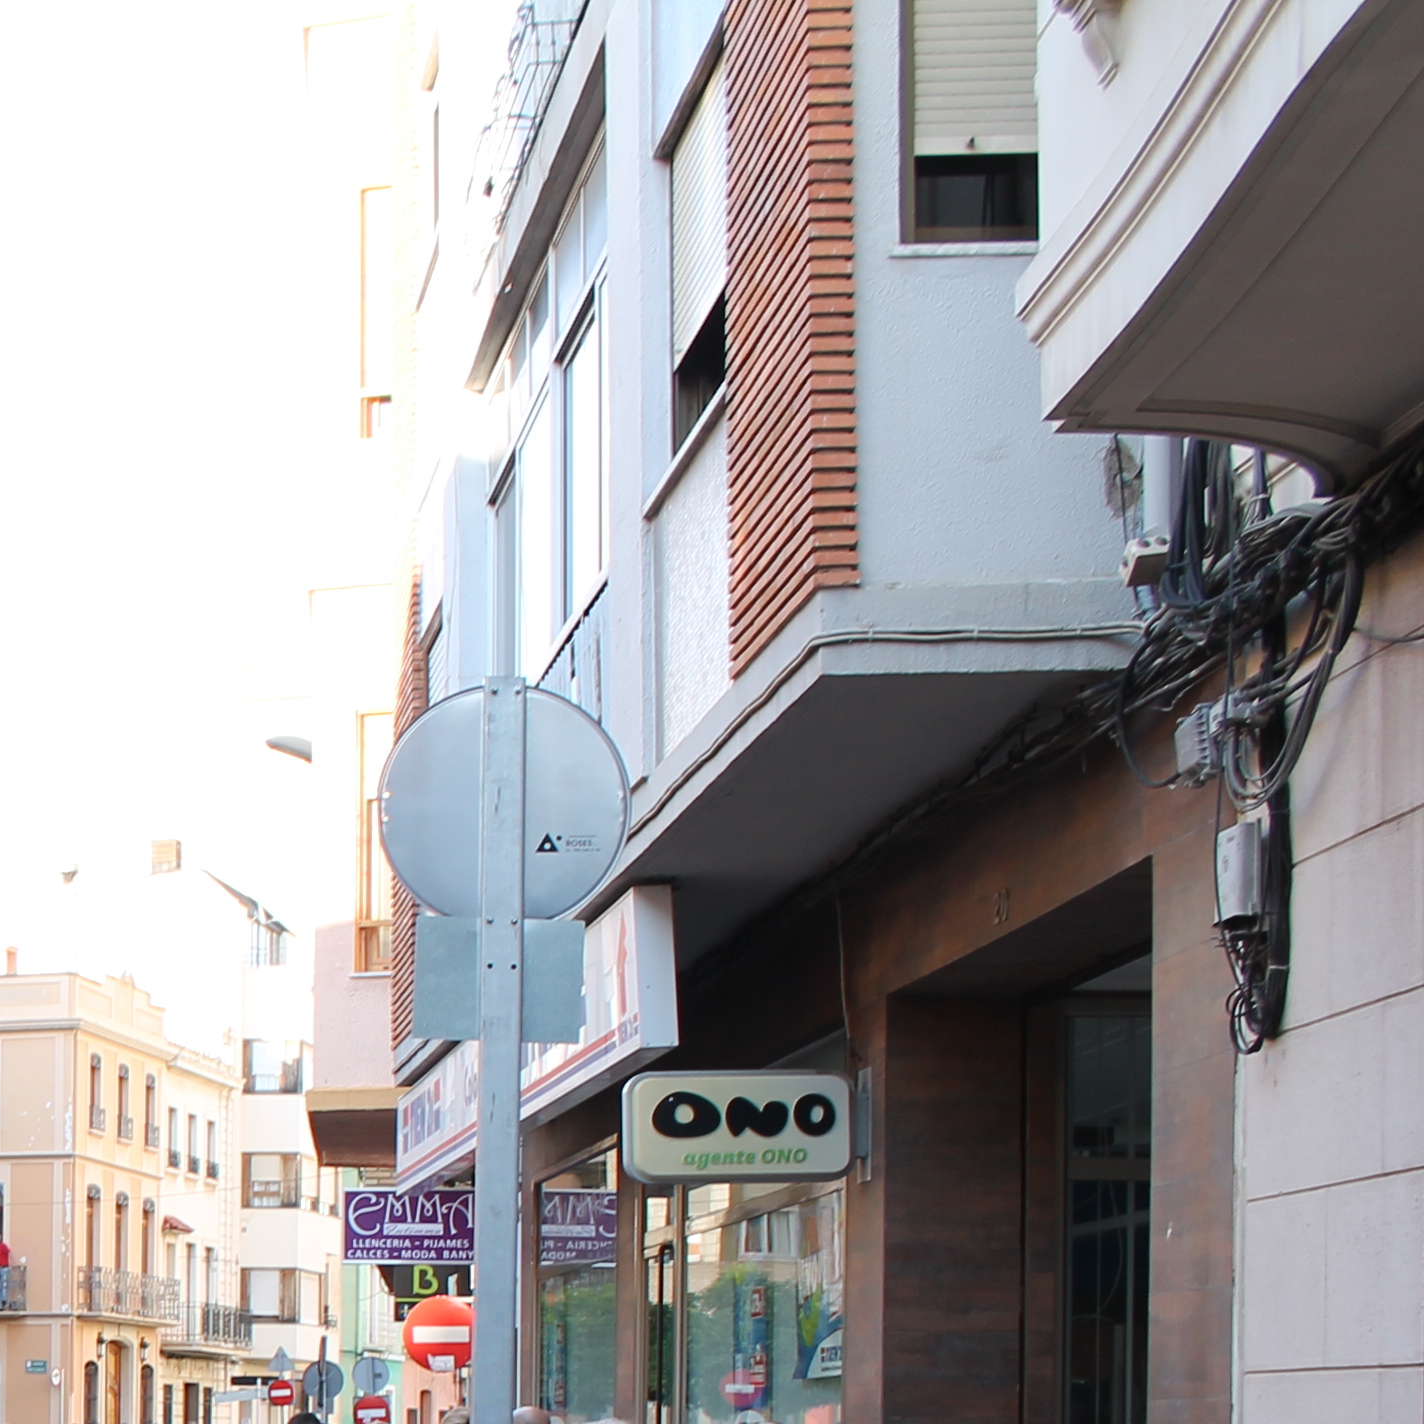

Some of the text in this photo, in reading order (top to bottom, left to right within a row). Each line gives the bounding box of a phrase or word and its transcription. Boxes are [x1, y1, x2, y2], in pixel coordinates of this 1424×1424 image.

[651, 1090, 837, 1139] ONO
[682, 1148, 808, 1169] agente ONO
[348, 1192, 475, 1236] EMMA
[352, 1238, 411, 1249] LLENCERIA
[423, 1238, 470, 1249] PIJAMES
[347, 1249, 390, 1259] CALCES
[402, 1249, 438, 1260] MODA
[442, 1250, 475, 1260] BANY
